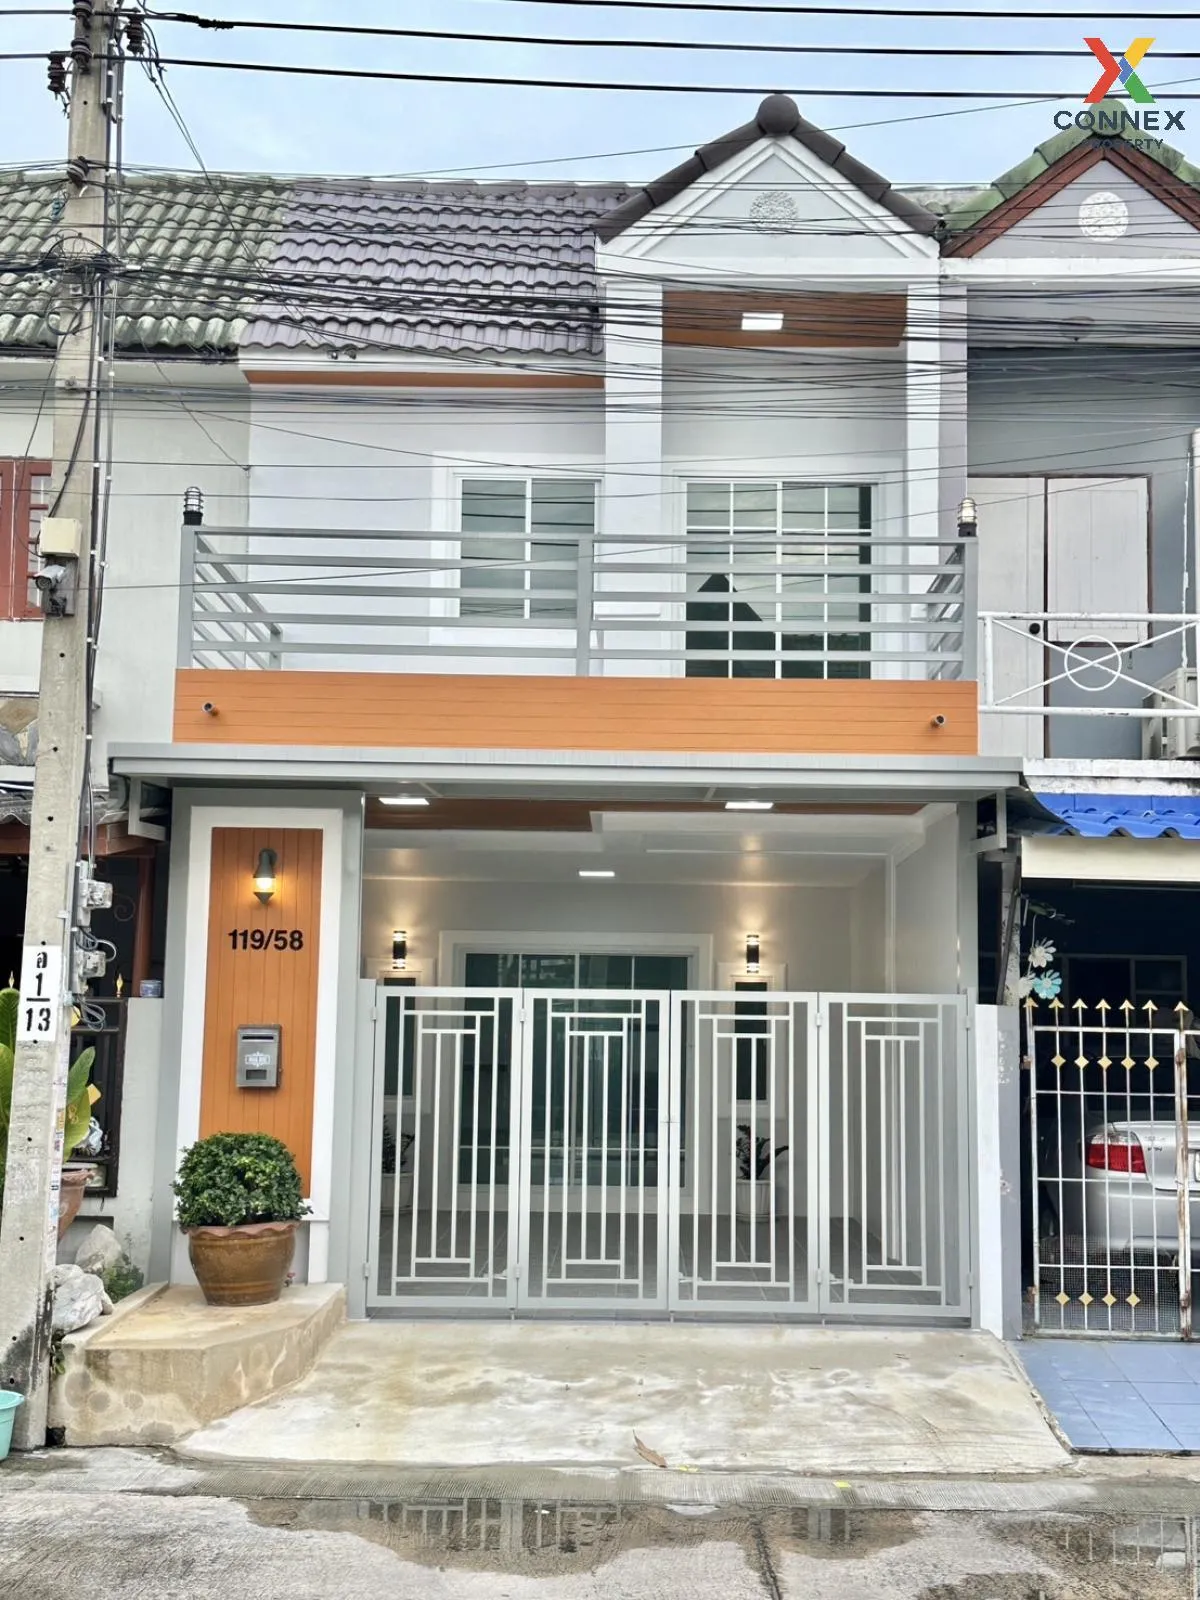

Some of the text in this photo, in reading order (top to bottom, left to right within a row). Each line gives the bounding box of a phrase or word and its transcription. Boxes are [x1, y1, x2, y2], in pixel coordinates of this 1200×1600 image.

[228, 929, 304, 951] 119/58
[35, 972, 43, 997] 1
[26, 1007, 51, 1032] 13
